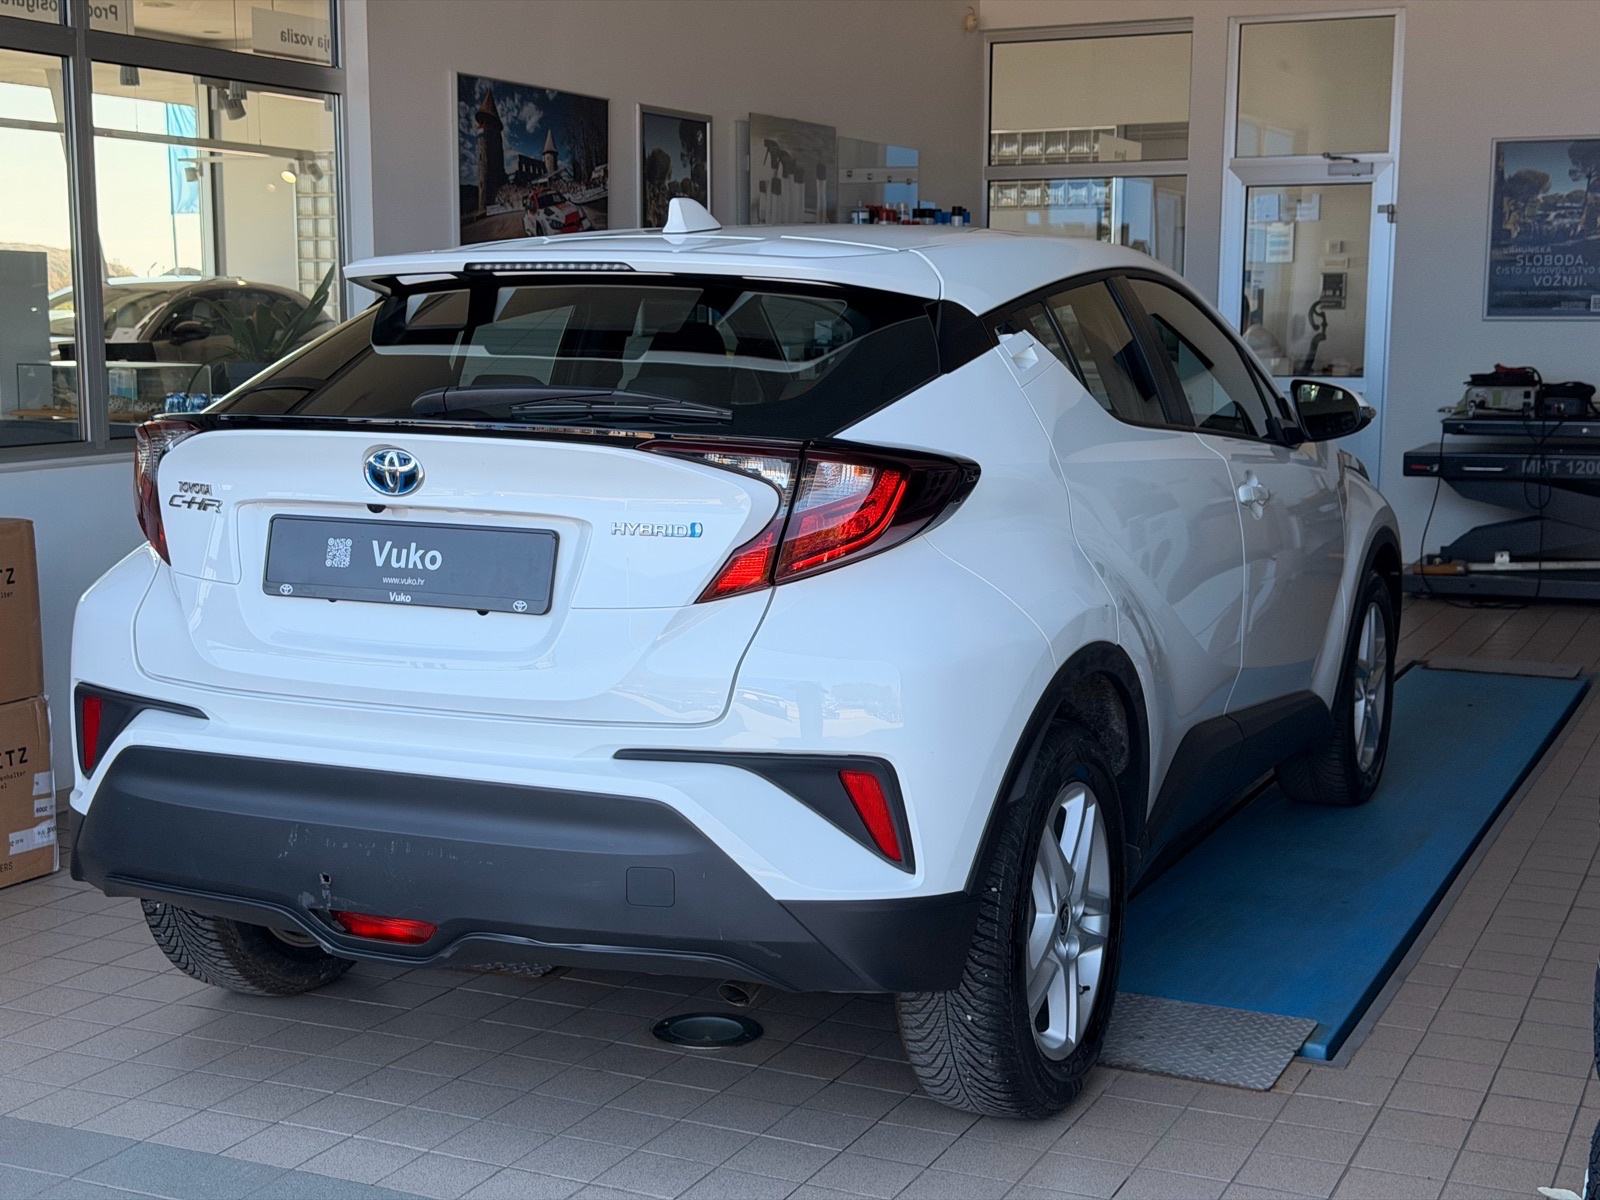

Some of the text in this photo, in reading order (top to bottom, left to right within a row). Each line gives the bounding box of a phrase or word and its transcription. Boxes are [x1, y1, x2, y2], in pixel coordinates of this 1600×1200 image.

[1516, 254, 1588, 266] SLOBODA.
[1533, 273, 1587, 286] VOŽNJI.
[178, 481, 212, 496] TOYOTA
[610, 521, 688, 538] HYBRID
[372, 540, 442, 571] Vuko
[382, 577, 425, 586] www.vuko.hr
[389, 591, 412, 602] Vuko
